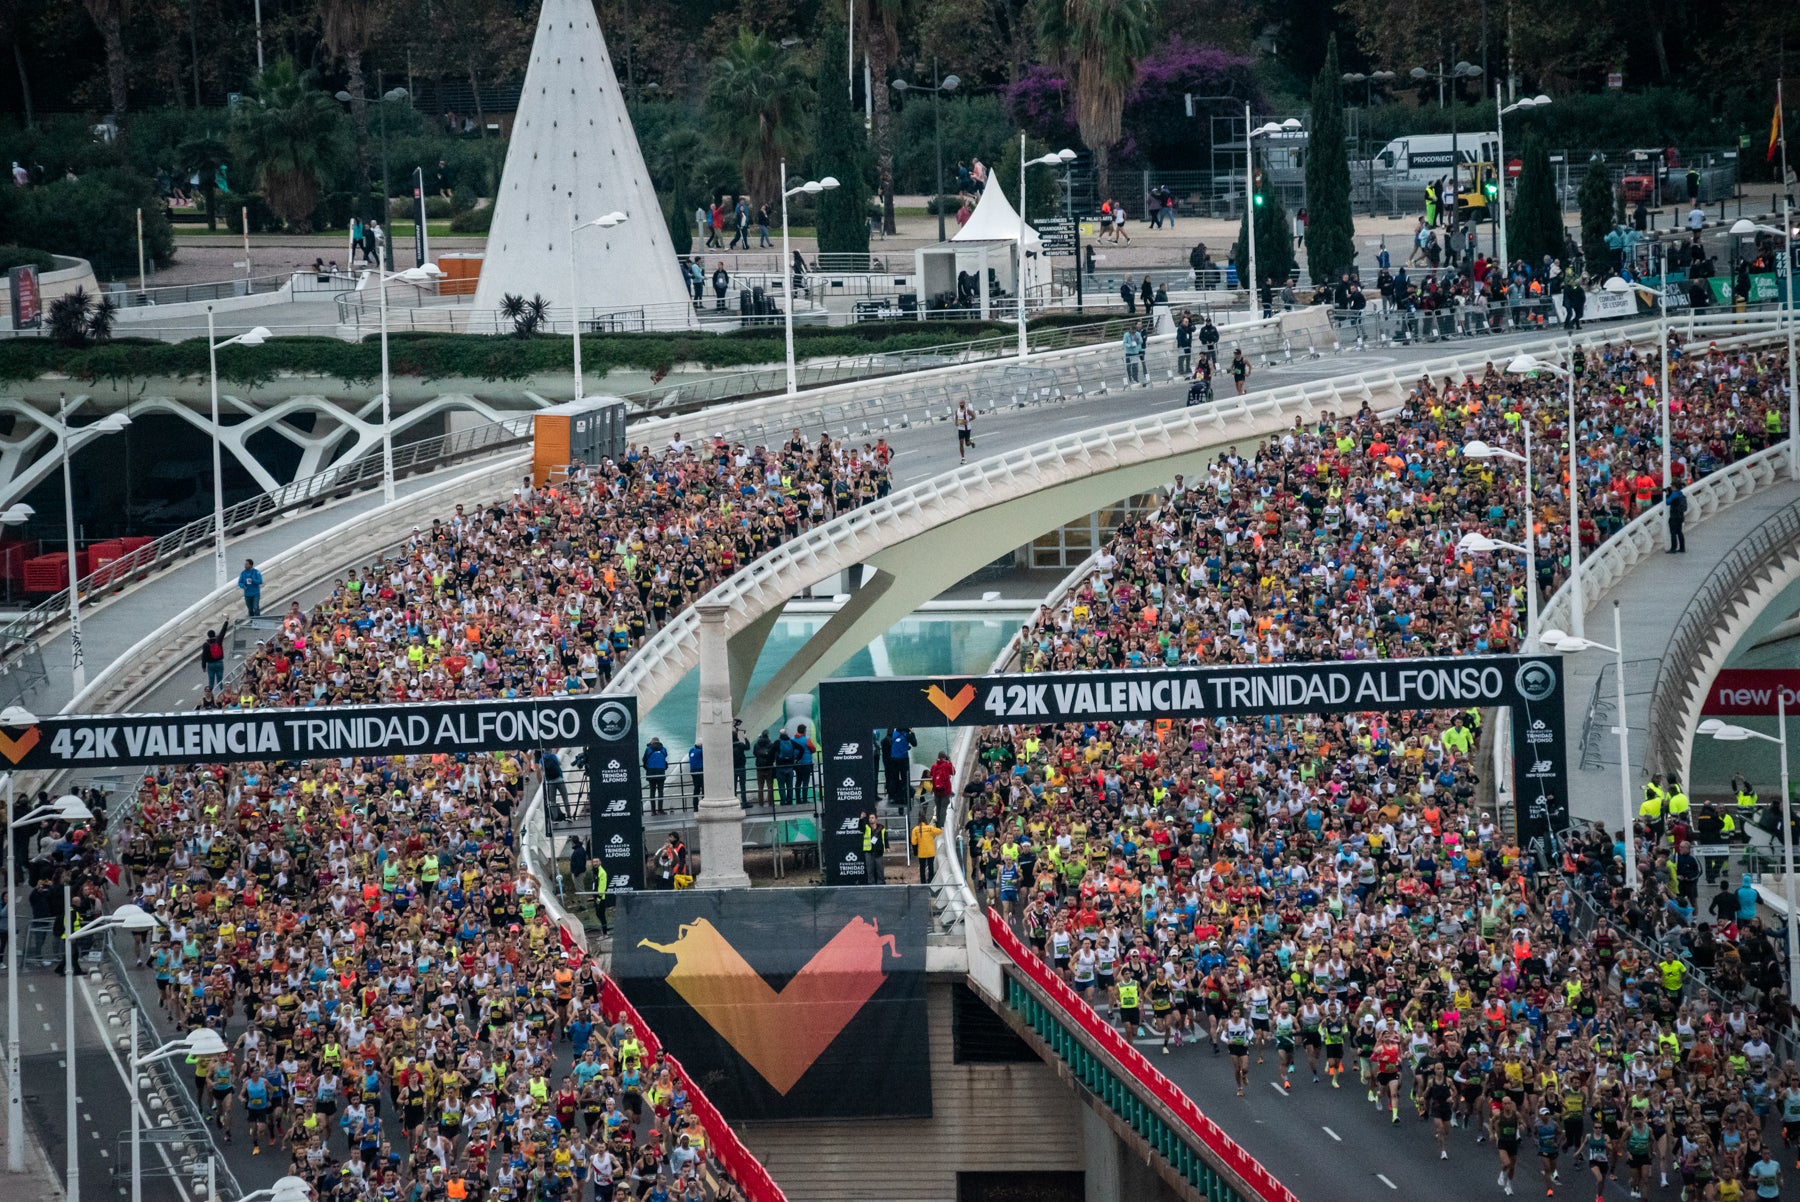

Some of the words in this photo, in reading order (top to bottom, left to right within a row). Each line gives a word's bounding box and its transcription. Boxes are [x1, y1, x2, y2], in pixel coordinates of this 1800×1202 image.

[984, 684, 1049, 716] 42K
[1053, 679, 1204, 714] VALENCIA
[1207, 674, 1350, 708] TRINIDAD
[1355, 667, 1503, 703] ALFONSO
[1720, 688, 1772, 706] new
[50, 727, 118, 759] 42K
[123, 721, 281, 757] VALENCIA
[284, 714, 430, 751] TRINIDAD
[434, 707, 580, 745] ALFONSO
